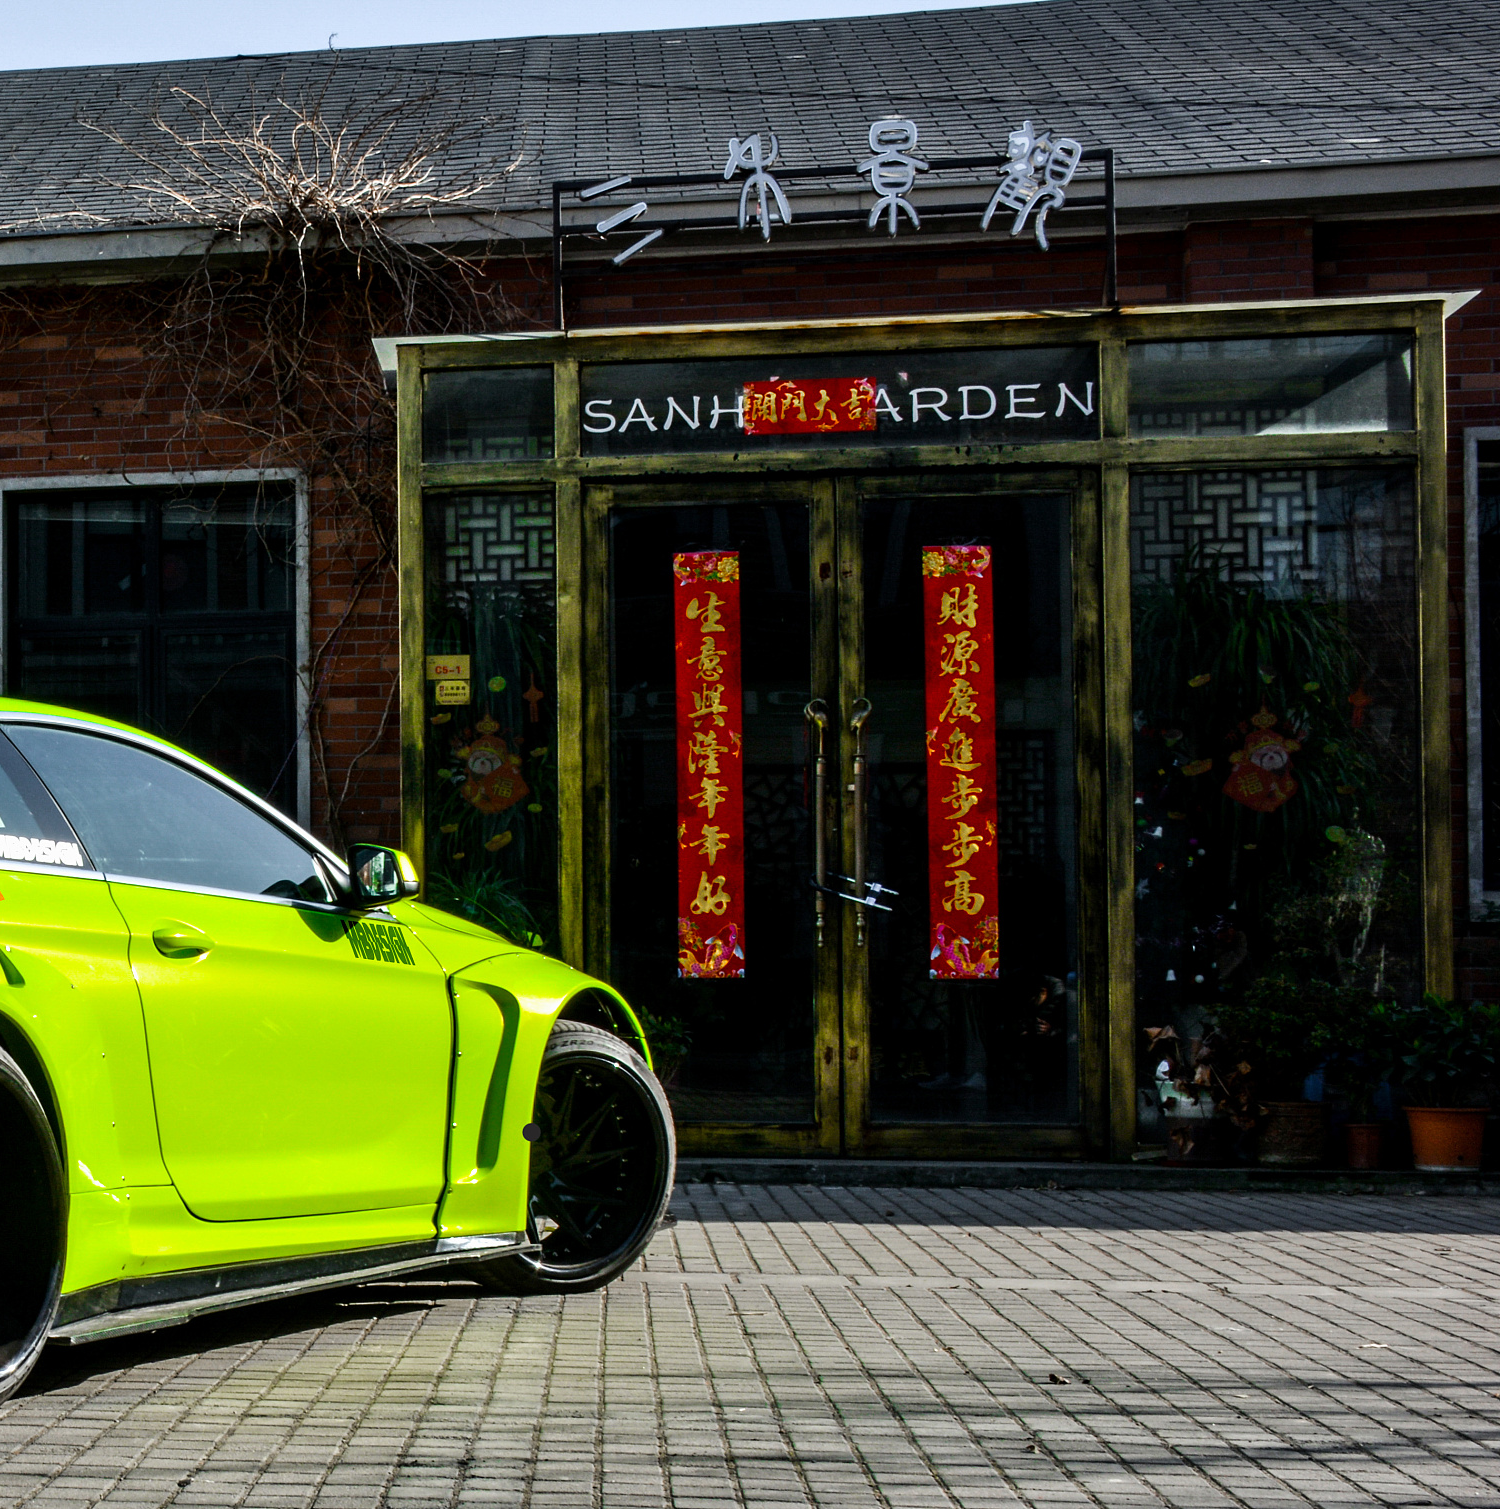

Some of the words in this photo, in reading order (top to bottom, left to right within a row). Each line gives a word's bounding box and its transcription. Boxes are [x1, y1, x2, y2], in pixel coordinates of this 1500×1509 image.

[583, 395, 744, 433] SANH
[875, 381, 1094, 422] ARDEN
[435, 665, 461, 674] C5-1
[493, 776, 514, 798] 福
[1238, 773, 1263, 797] 福
